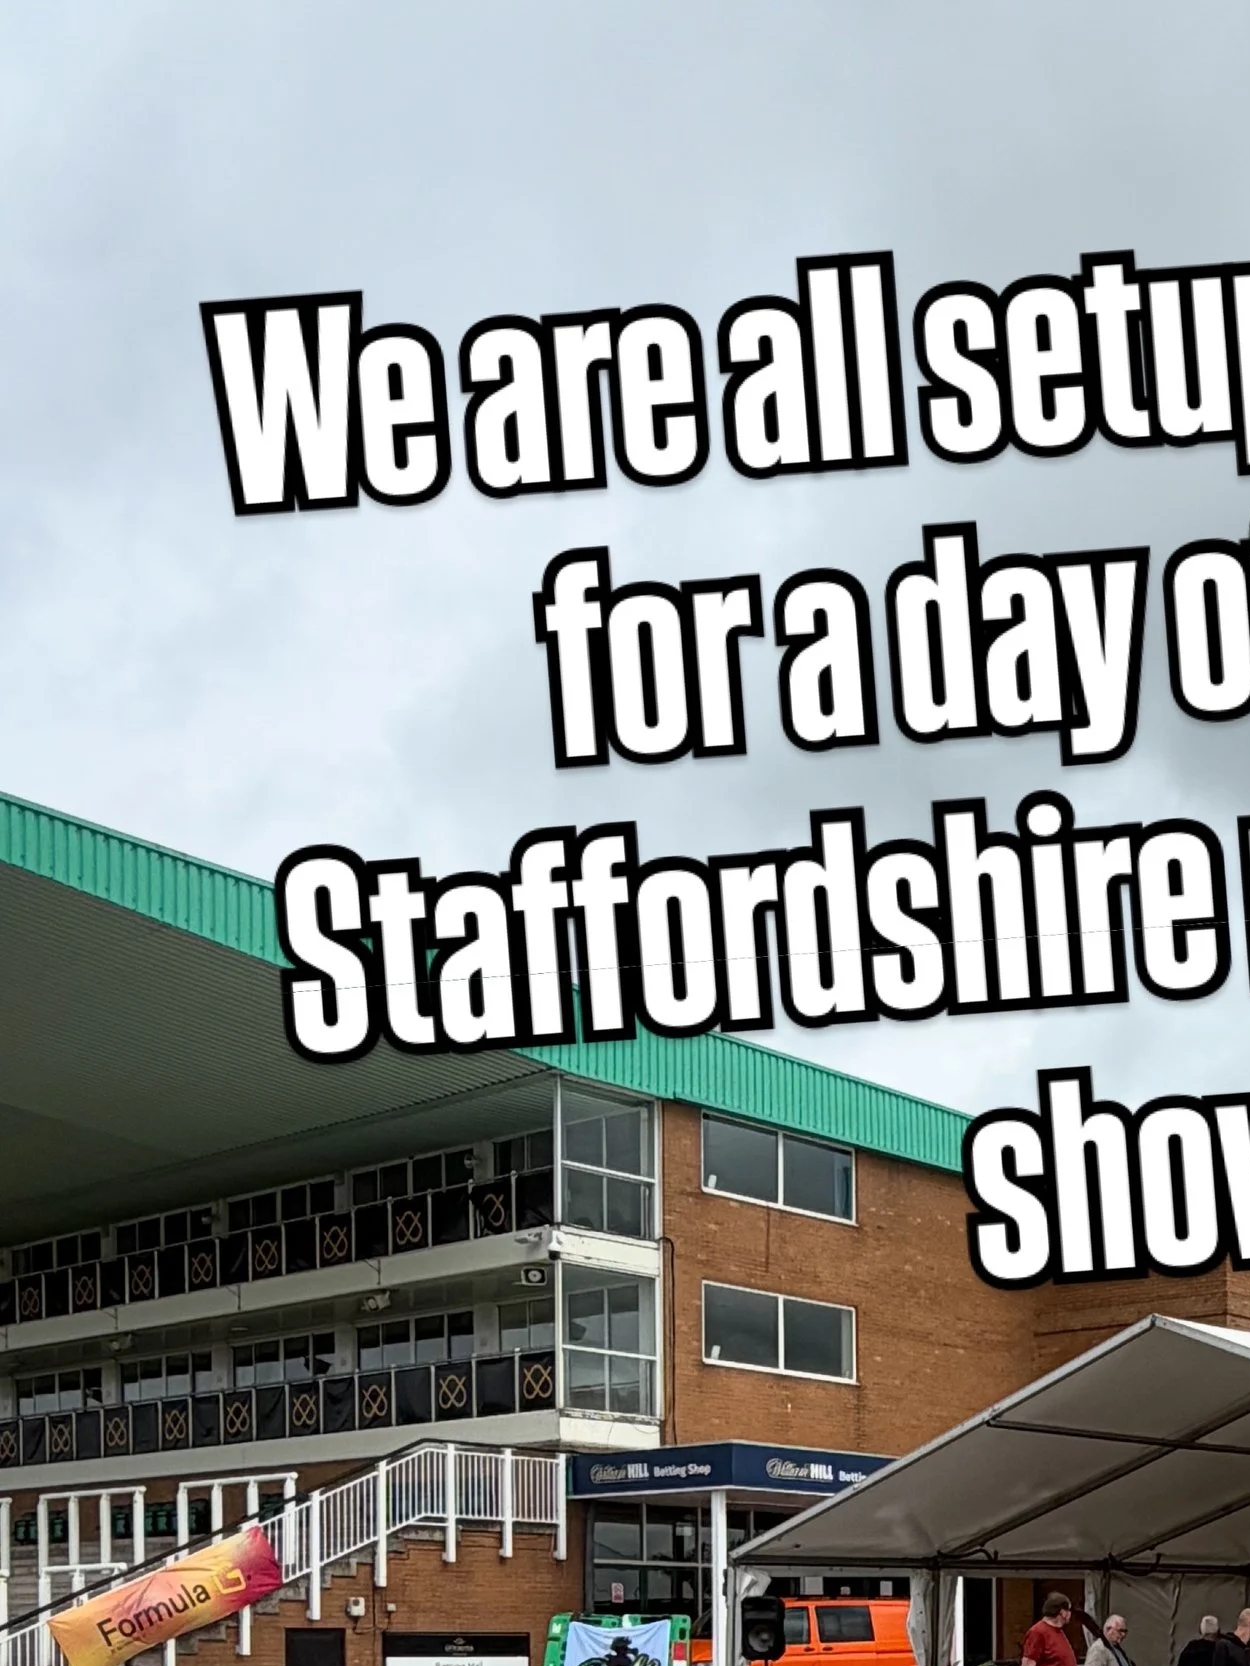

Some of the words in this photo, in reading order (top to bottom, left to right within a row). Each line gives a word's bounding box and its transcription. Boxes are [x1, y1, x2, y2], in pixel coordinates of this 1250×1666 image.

[627, 1463, 650, 1479] HILL
[653, 1465, 687, 1478] Betting
[687, 1463, 711, 1476] Shop
[810, 1463, 834, 1481] HILL
[96, 1583, 211, 1647] Formula
